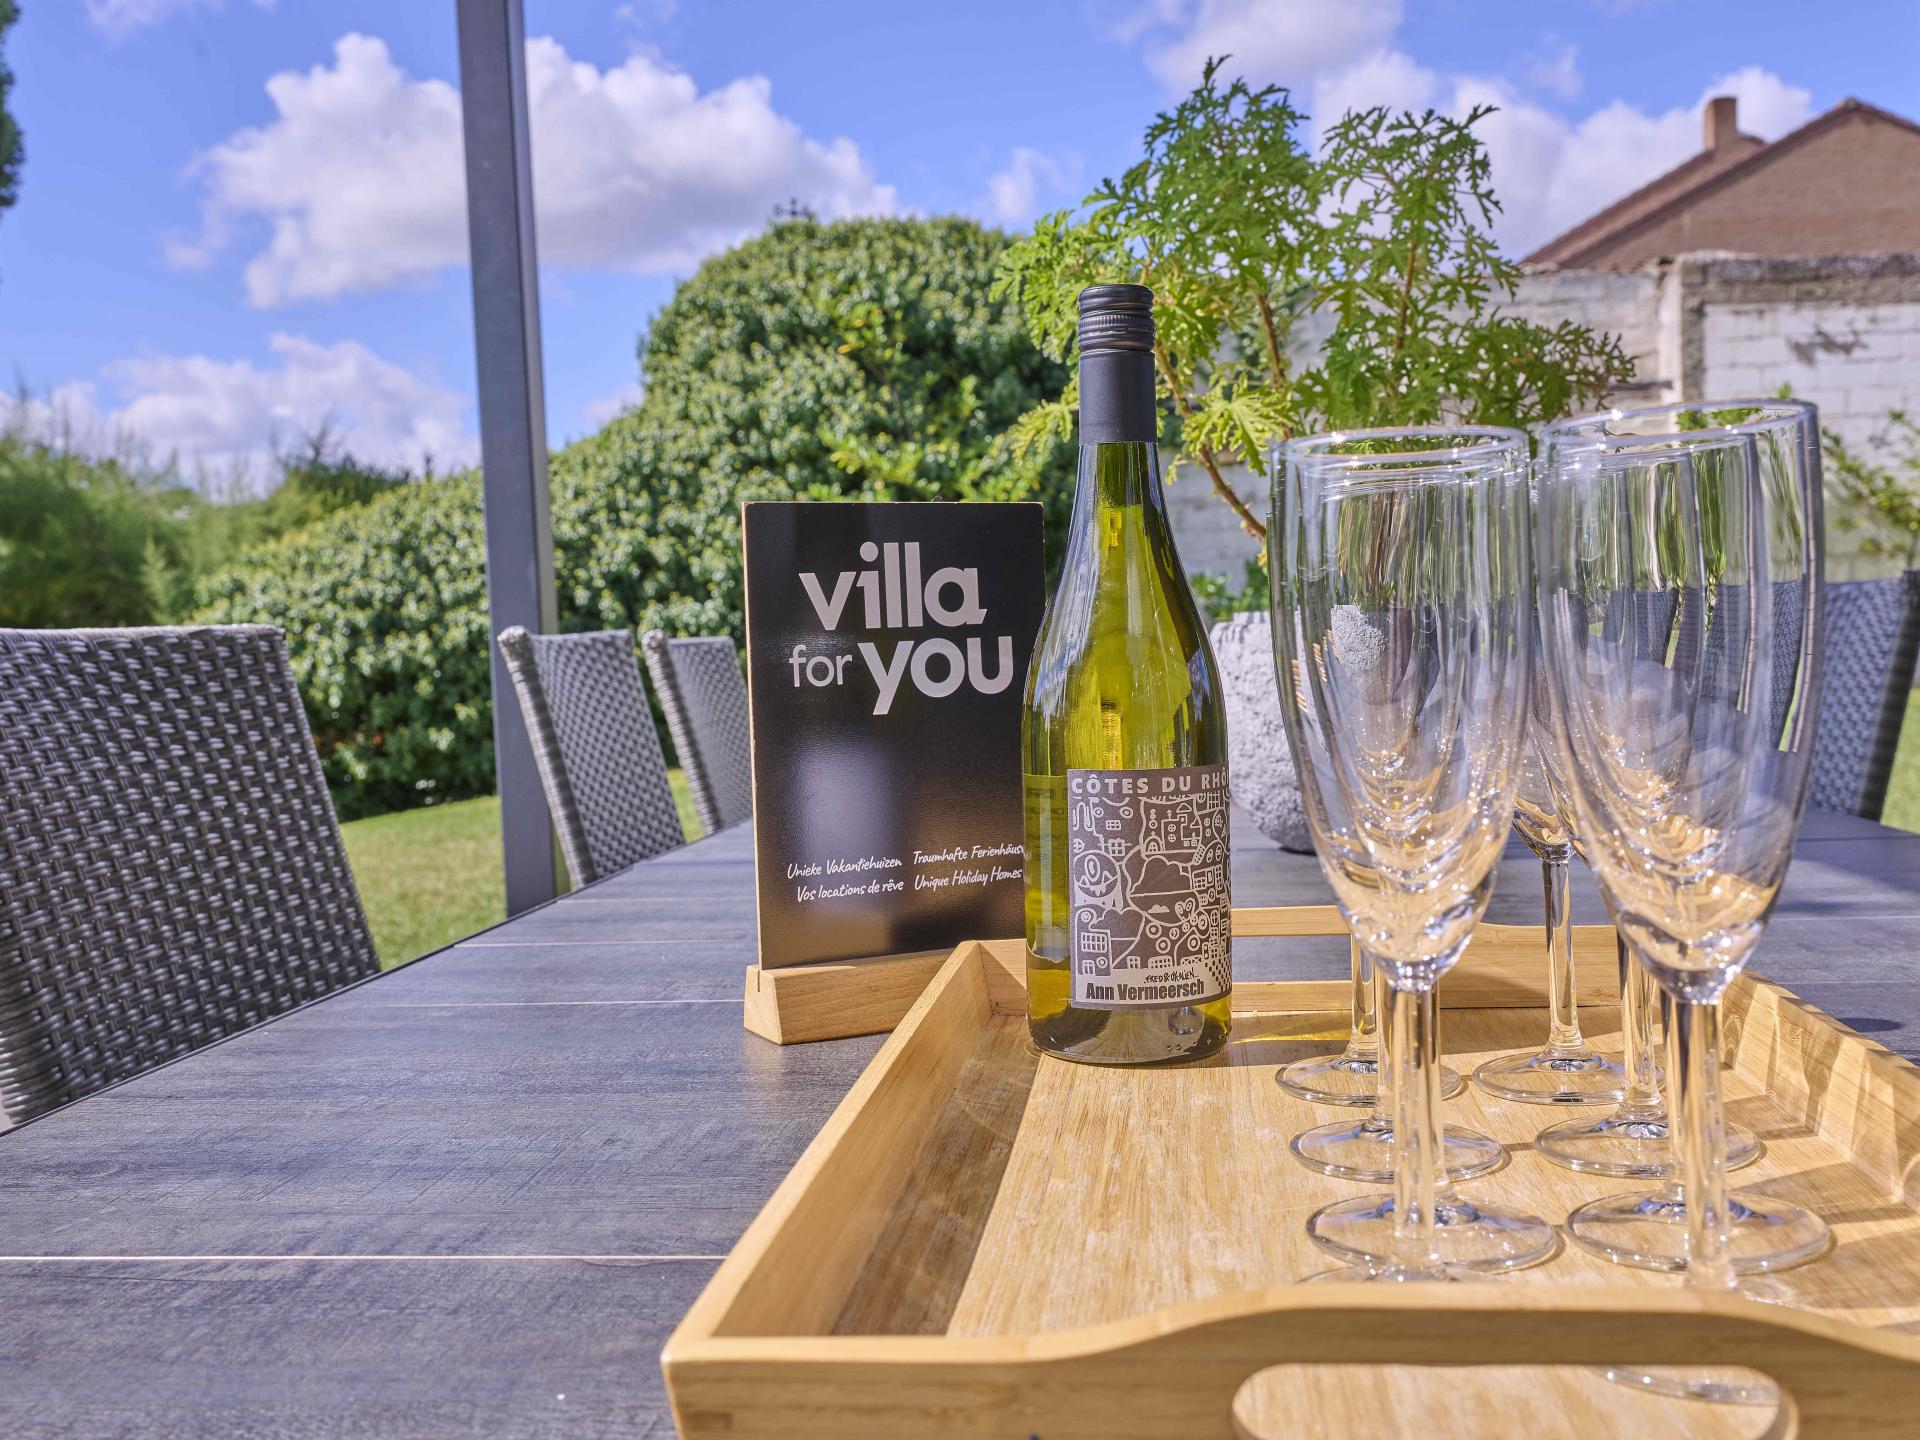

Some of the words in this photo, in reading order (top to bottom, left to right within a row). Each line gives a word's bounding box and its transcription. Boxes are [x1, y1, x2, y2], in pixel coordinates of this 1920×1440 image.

[799, 541, 988, 631] villa
[789, 644, 852, 687] for
[857, 635, 1014, 715] you
[1071, 774, 1149, 794] CÔTES
[1161, 775, 1191, 793] DU
[787, 863, 822, 879] Unieke
[826, 856, 902, 875] Vakantiehuizen
[913, 847, 968, 865] Traumhafte
[797, 885, 817, 902] Vos
[818, 884, 866, 898] locations
[867, 879, 880, 894] de
[881, 879, 904, 892] rêve
[914, 874, 949, 892] Unique
[952, 869, 989, 886] Holiday
[990, 866, 1023, 882] Homes
[1086, 982, 1115, 1000] Ann
[1117, 979, 1205, 1001] Vermeersch
